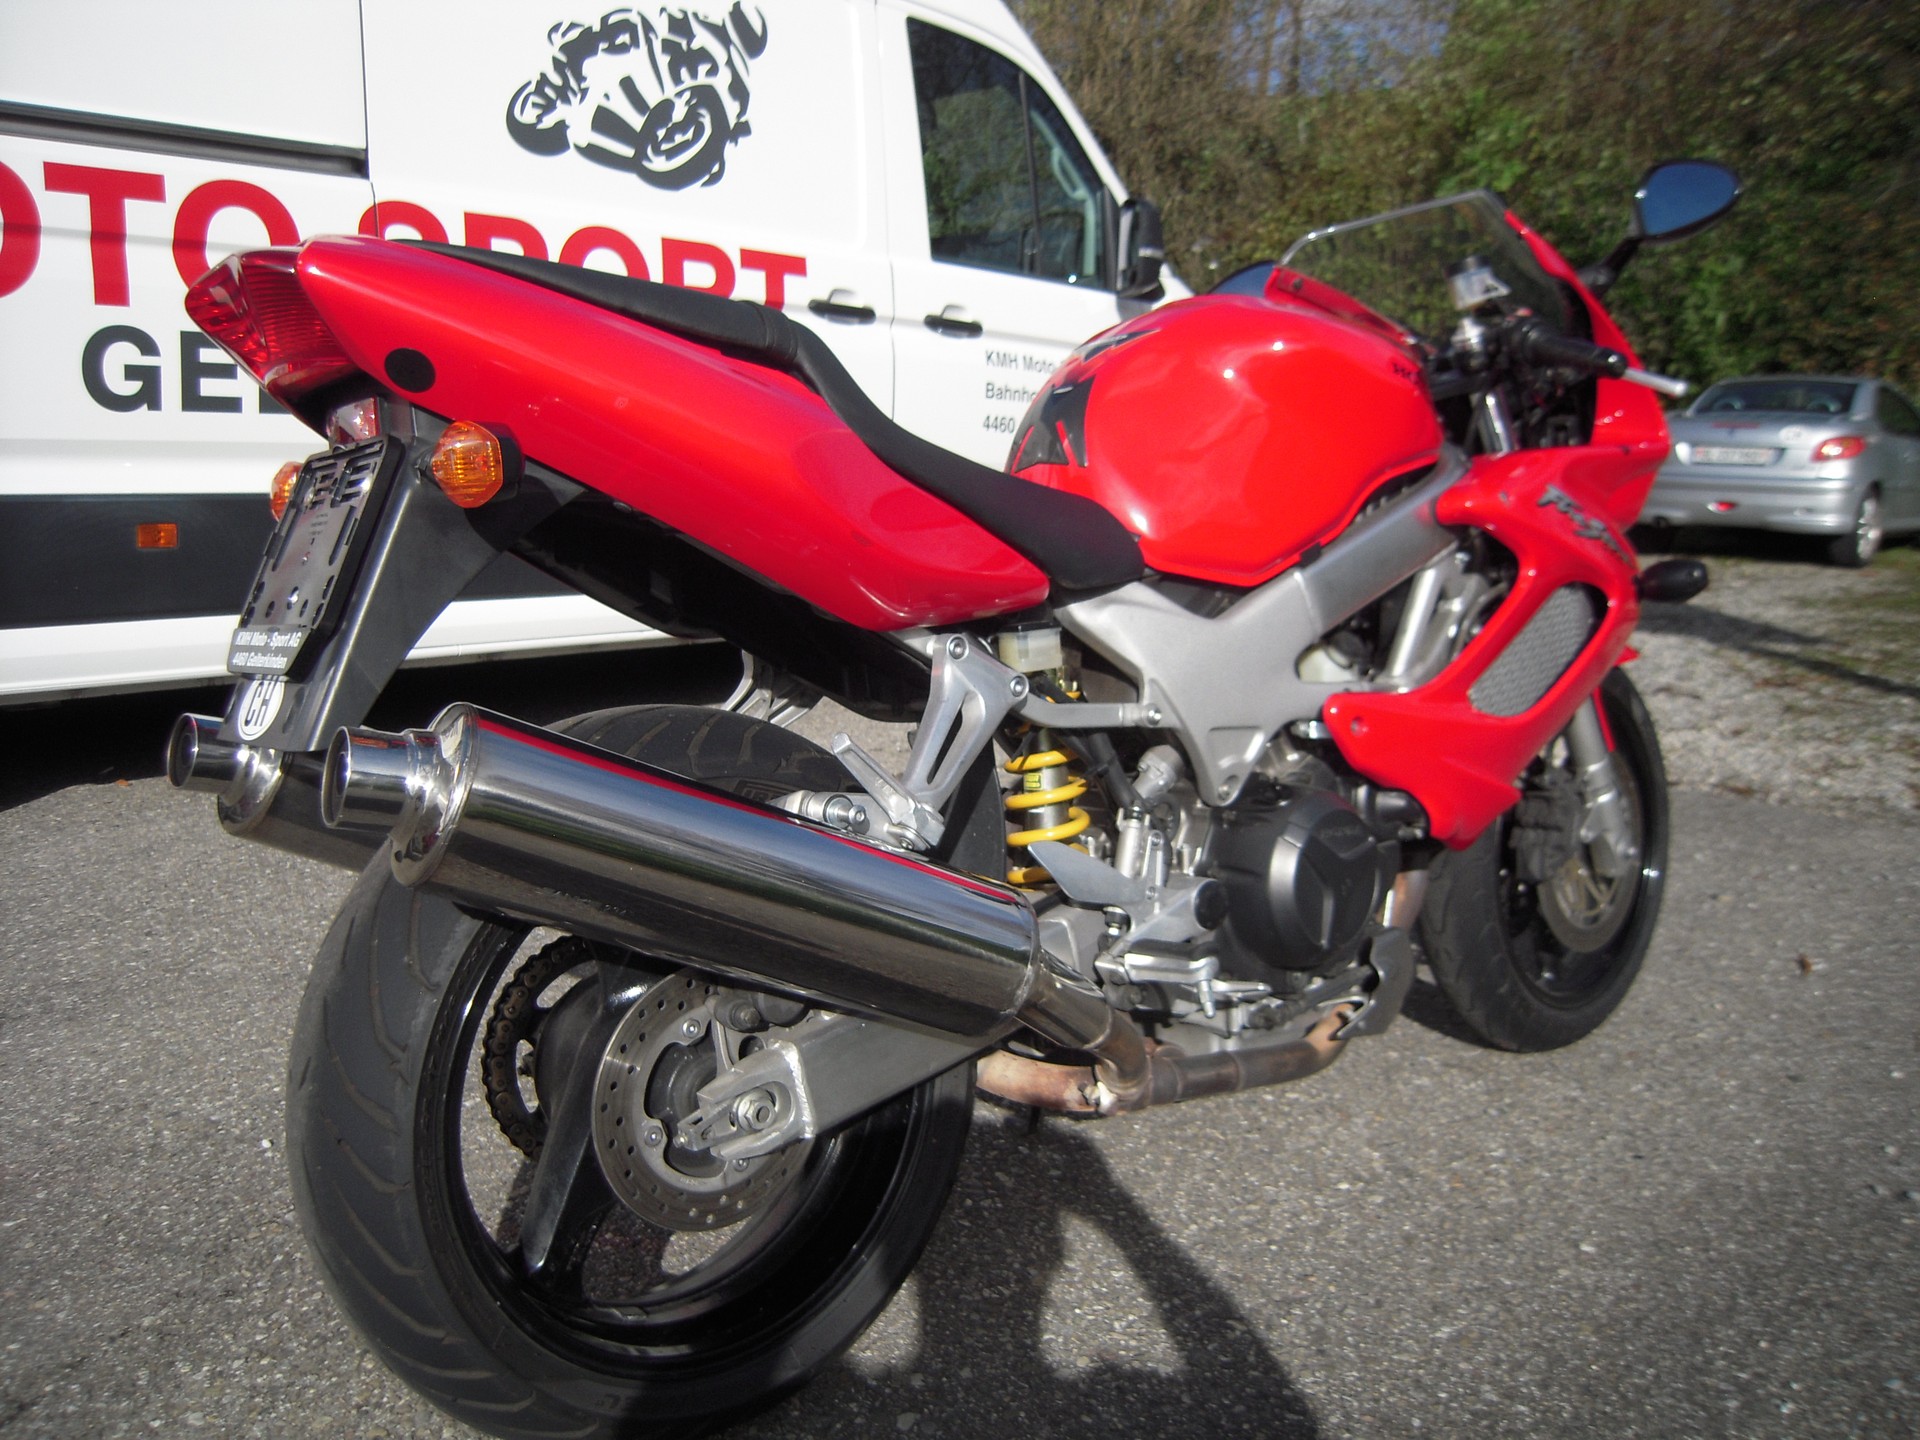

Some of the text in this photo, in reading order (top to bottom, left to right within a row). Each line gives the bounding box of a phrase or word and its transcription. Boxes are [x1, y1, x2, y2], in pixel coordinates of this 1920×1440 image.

[0, 160, 303, 308] TO
[985, 350, 1018, 370] KMH
[983, 415, 1015, 434] 4460
[269, 631, 291, 651] Sport
[287, 631, 303, 648] AG
